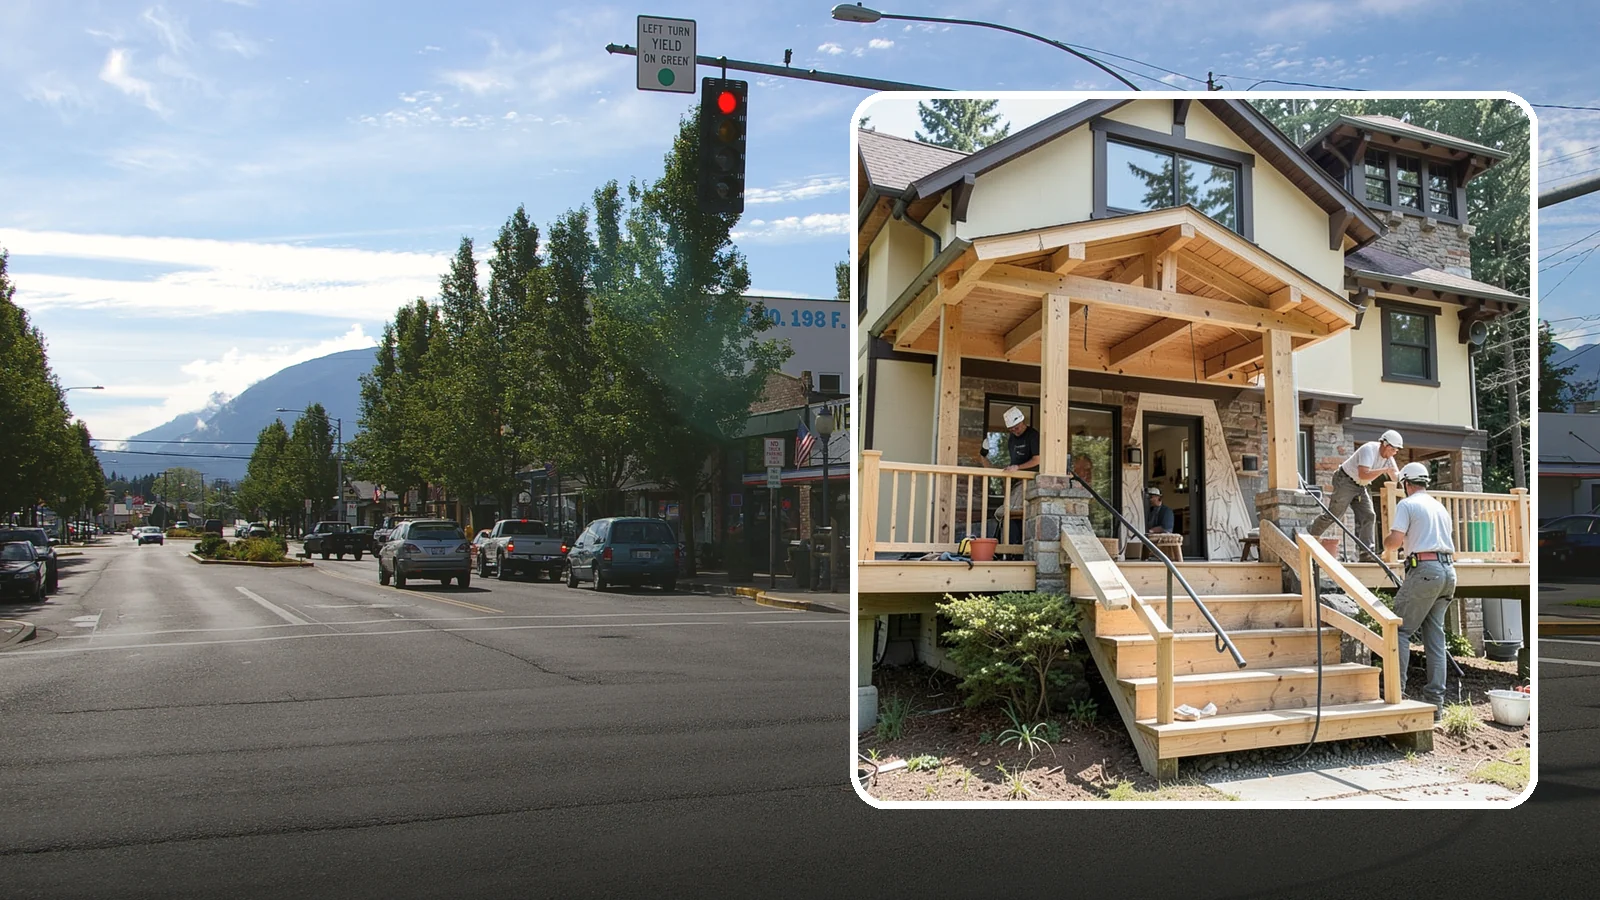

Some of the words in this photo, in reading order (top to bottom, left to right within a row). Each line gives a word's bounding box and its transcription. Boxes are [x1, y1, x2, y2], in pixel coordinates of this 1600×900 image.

[643, 24, 663, 34] LEFT
[668, 25, 690, 36] TURN
[652, 38, 682, 52] YIELD
[644, 53, 656, 64] ON
[661, 54, 689, 66] GREEN
[791, 309, 826, 328] 198
[831, 311, 847, 329] F.
